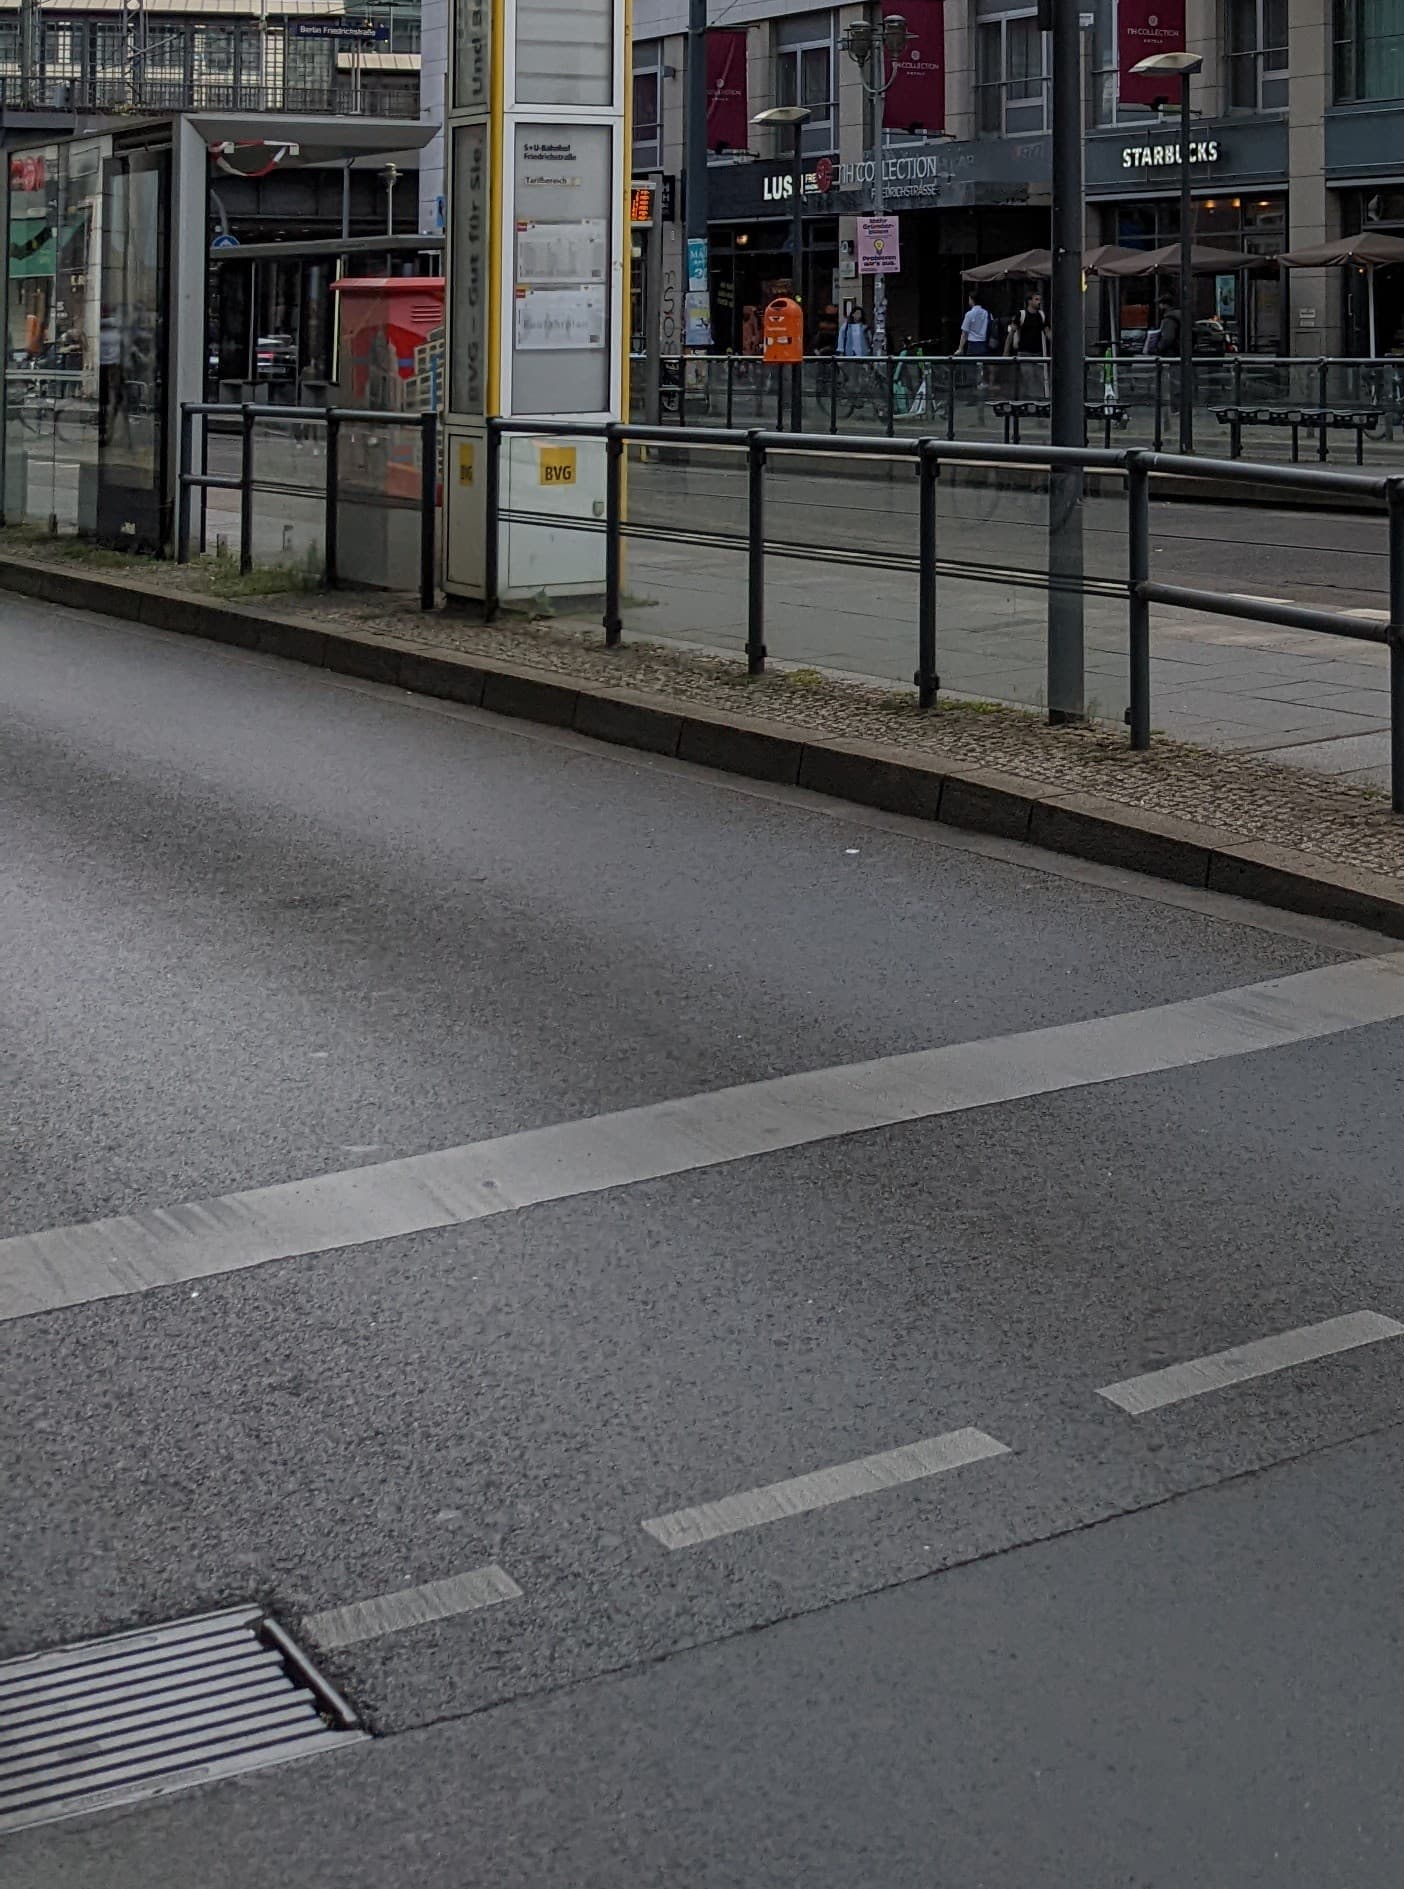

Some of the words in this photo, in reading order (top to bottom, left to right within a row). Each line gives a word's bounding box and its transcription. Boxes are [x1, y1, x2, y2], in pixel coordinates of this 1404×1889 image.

[300, 25, 321, 33] Berlin
[1138, 28, 1179, 37] COLLECTION
[472, 39, 483, 96] und
[857, 156, 937, 183] COLECTION
[871, 184, 938, 199] FEDRICHSTRASSE
[545, 466, 571, 480] BVG
